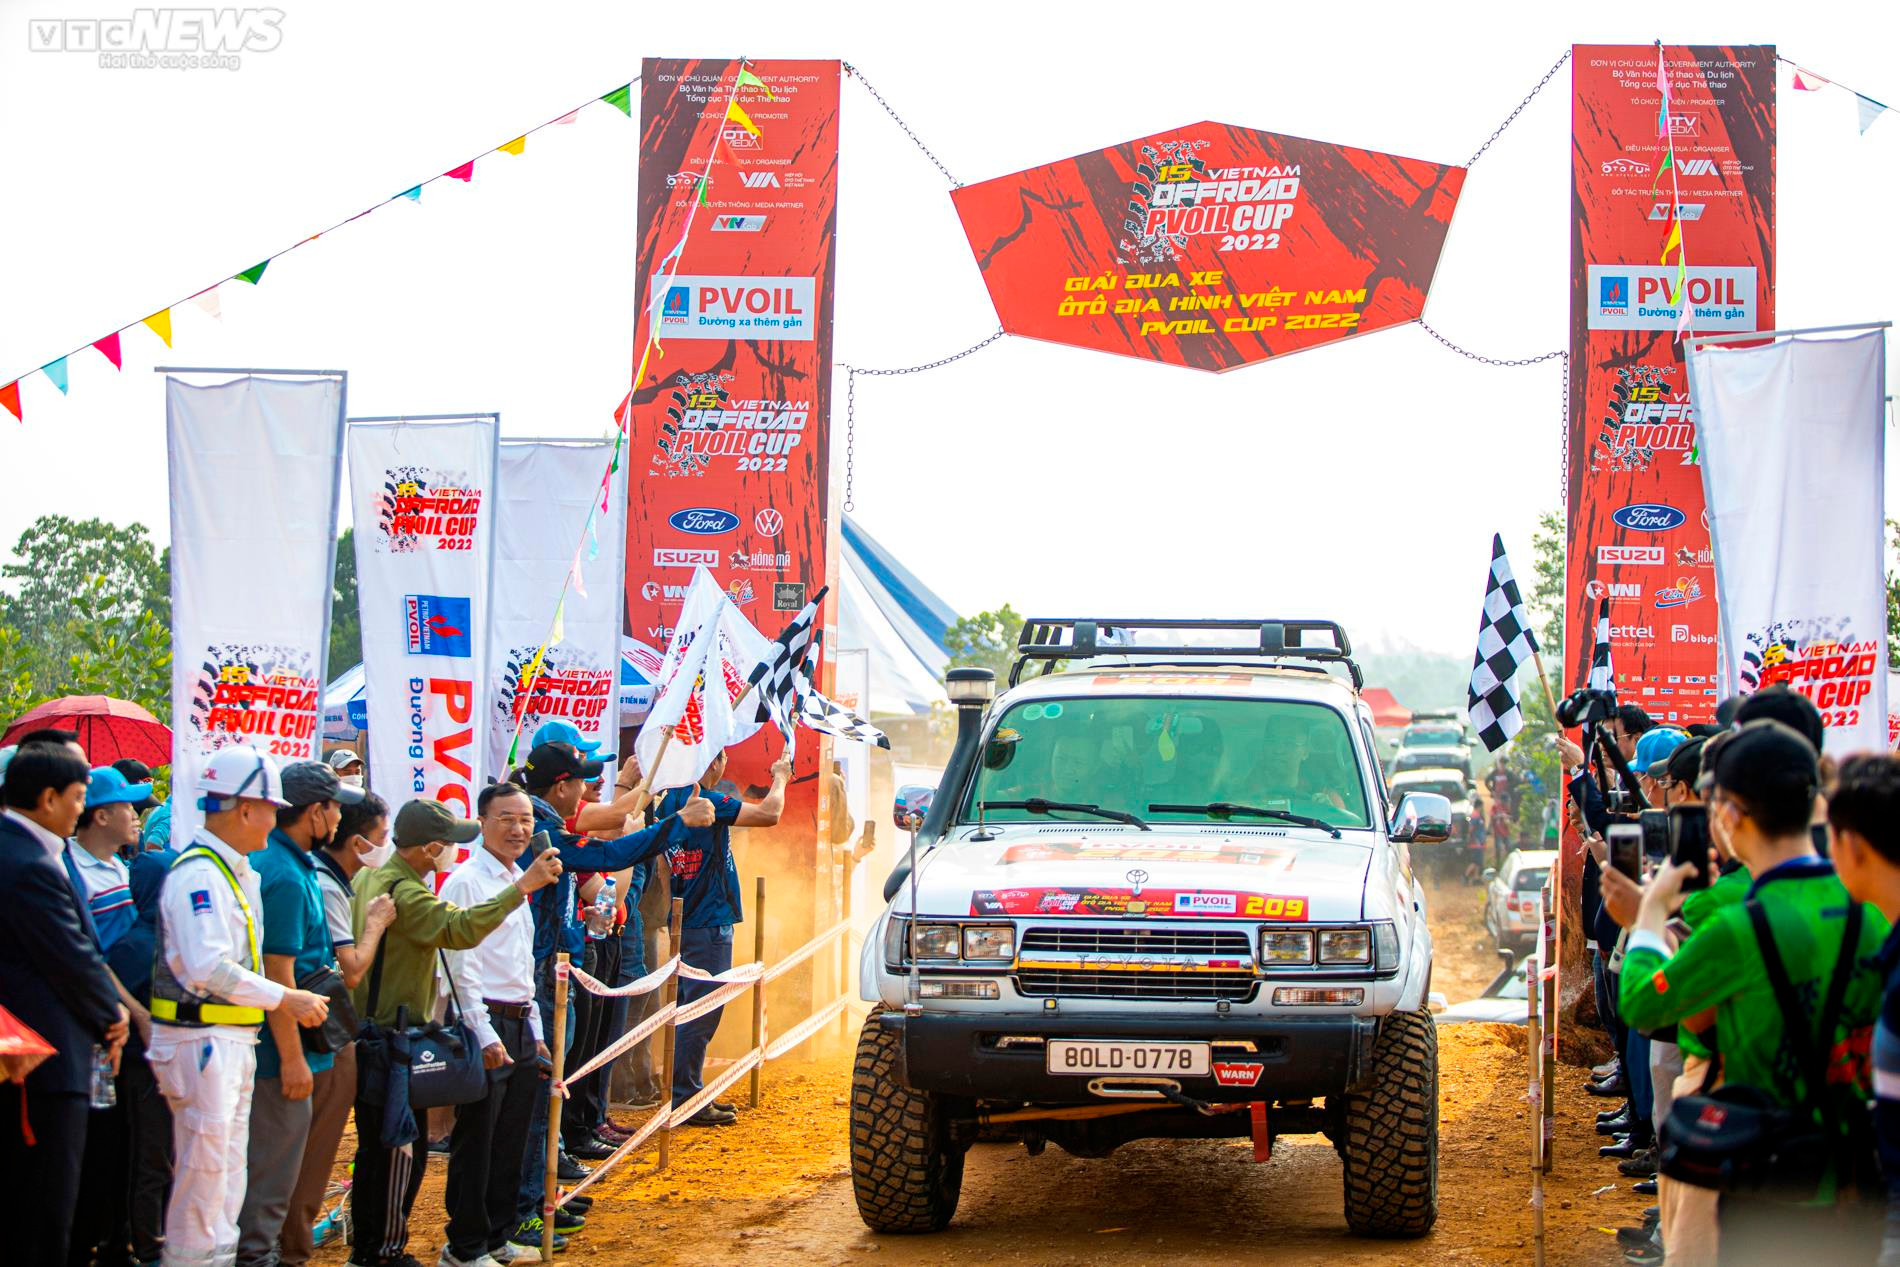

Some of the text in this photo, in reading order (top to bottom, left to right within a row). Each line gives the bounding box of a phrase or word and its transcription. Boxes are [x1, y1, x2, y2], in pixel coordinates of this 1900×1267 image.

[1709, 81, 1727, 89] thao
[1158, 164, 1301, 182] 15 VIETNAM
[1152, 178, 1301, 206] OFFROAD
[1144, 203, 1295, 237] PVOIL CUP
[1219, 233, 1281, 252] 2022
[1064, 270, 1223, 292] GIẢI ĐUA XE
[698, 287, 803, 315] PVOIL
[1637, 277, 1745, 306] PVOIL
[1057, 286, 1368, 321] ÔTÔ ĐỊA HÌNH VIỆT NAM
[1638, 307, 1677, 319] Đường
[1695, 308, 1722, 318] thêm
[1724, 306, 1745, 320] gần
[698, 315, 803, 330] Đường xa thêm gần
[1140, 312, 1361, 336] PVOIL CUP 2022
[689, 394, 810, 410] 15 VIETNAM
[1630, 387, 1660, 402] 15
[682, 411, 809, 431] OFFROAD
[673, 431, 801, 456] PVOIL CUP
[1616, 424, 1691, 450] PVOIL
[735, 457, 788, 472] 2022
[429, 488, 482, 497] VIETNAM
[395, 498, 481, 515] OFFROAD
[392, 516, 477, 537] PVOIL CUP
[682, 510, 726, 531] Ford
[1626, 506, 1671, 528] Ford
[436, 538, 473, 551] 2022
[657, 552, 716, 564] ISUZU
[776, 550, 791, 567] MÃ
[1600, 549, 1661, 561] ISUZU
[1607, 583, 1641, 597] VNI
[777, 599, 798, 609] Royal
[408, 600, 421, 649] PVOIL
[1798, 640, 1878, 659] VIETNAM
[221, 665, 251, 683] 15
[557, 669, 613, 679] VIETNAM
[1759, 653, 1877, 690] OFFROAD
[1816, 680, 1872, 709] CUP
[572, 697, 608, 718] CUP
[207, 707, 317, 740] PVOIL CUP
[570, 719, 600, 732] 022
[1822, 709, 1860, 728] 022
[409, 677, 425, 793] Đường xa
[269, 740, 310, 758] 2022
[1193, 897, 1231, 905] PVOIL
[1245, 895, 1305, 917] 209
[1076, 953, 1199, 971] TOYOTA
[1065, 1046, 1193, 1069] 80LD-0778
[1220, 1069, 1255, 1080] WARN
